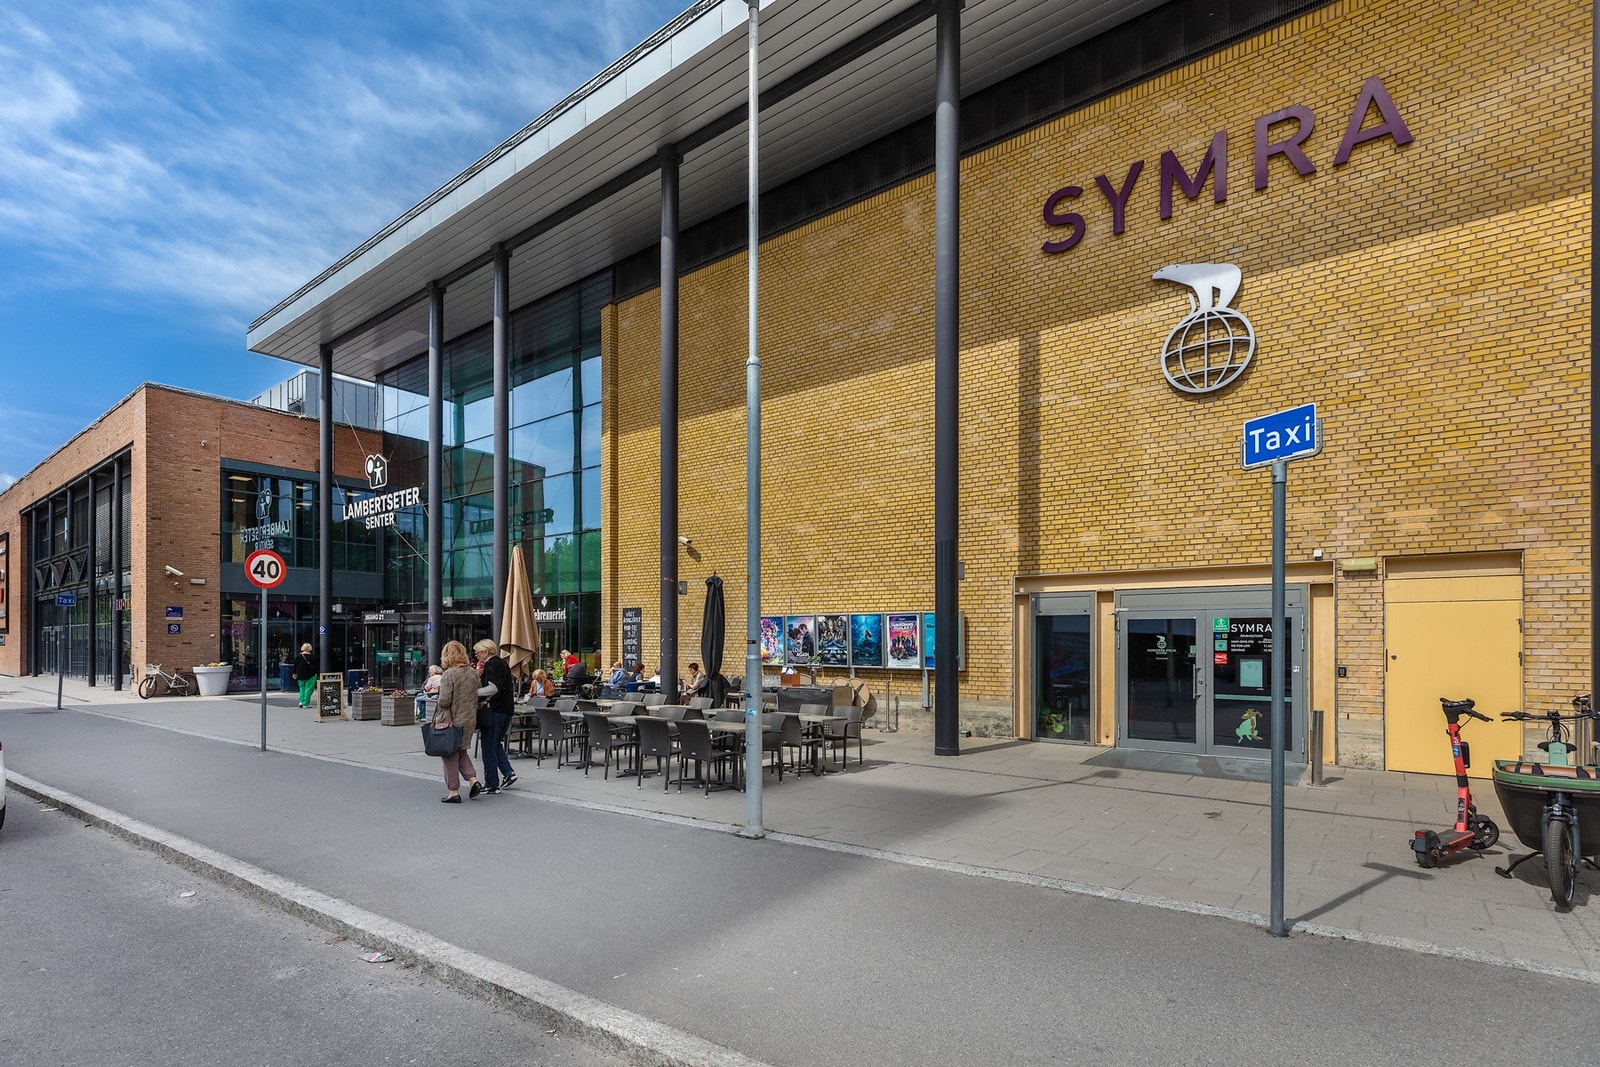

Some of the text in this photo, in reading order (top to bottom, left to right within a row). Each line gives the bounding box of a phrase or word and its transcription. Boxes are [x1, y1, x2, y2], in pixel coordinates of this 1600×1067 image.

[1041, 75, 1414, 253] SYMRA
[1249, 416, 1310, 453] Taxi
[343, 487, 420, 520] LAMBERTSETER
[365, 512, 394, 529] SENTER
[253, 560, 279, 579] 40
[1231, 624, 1272, 633] SYMRA
